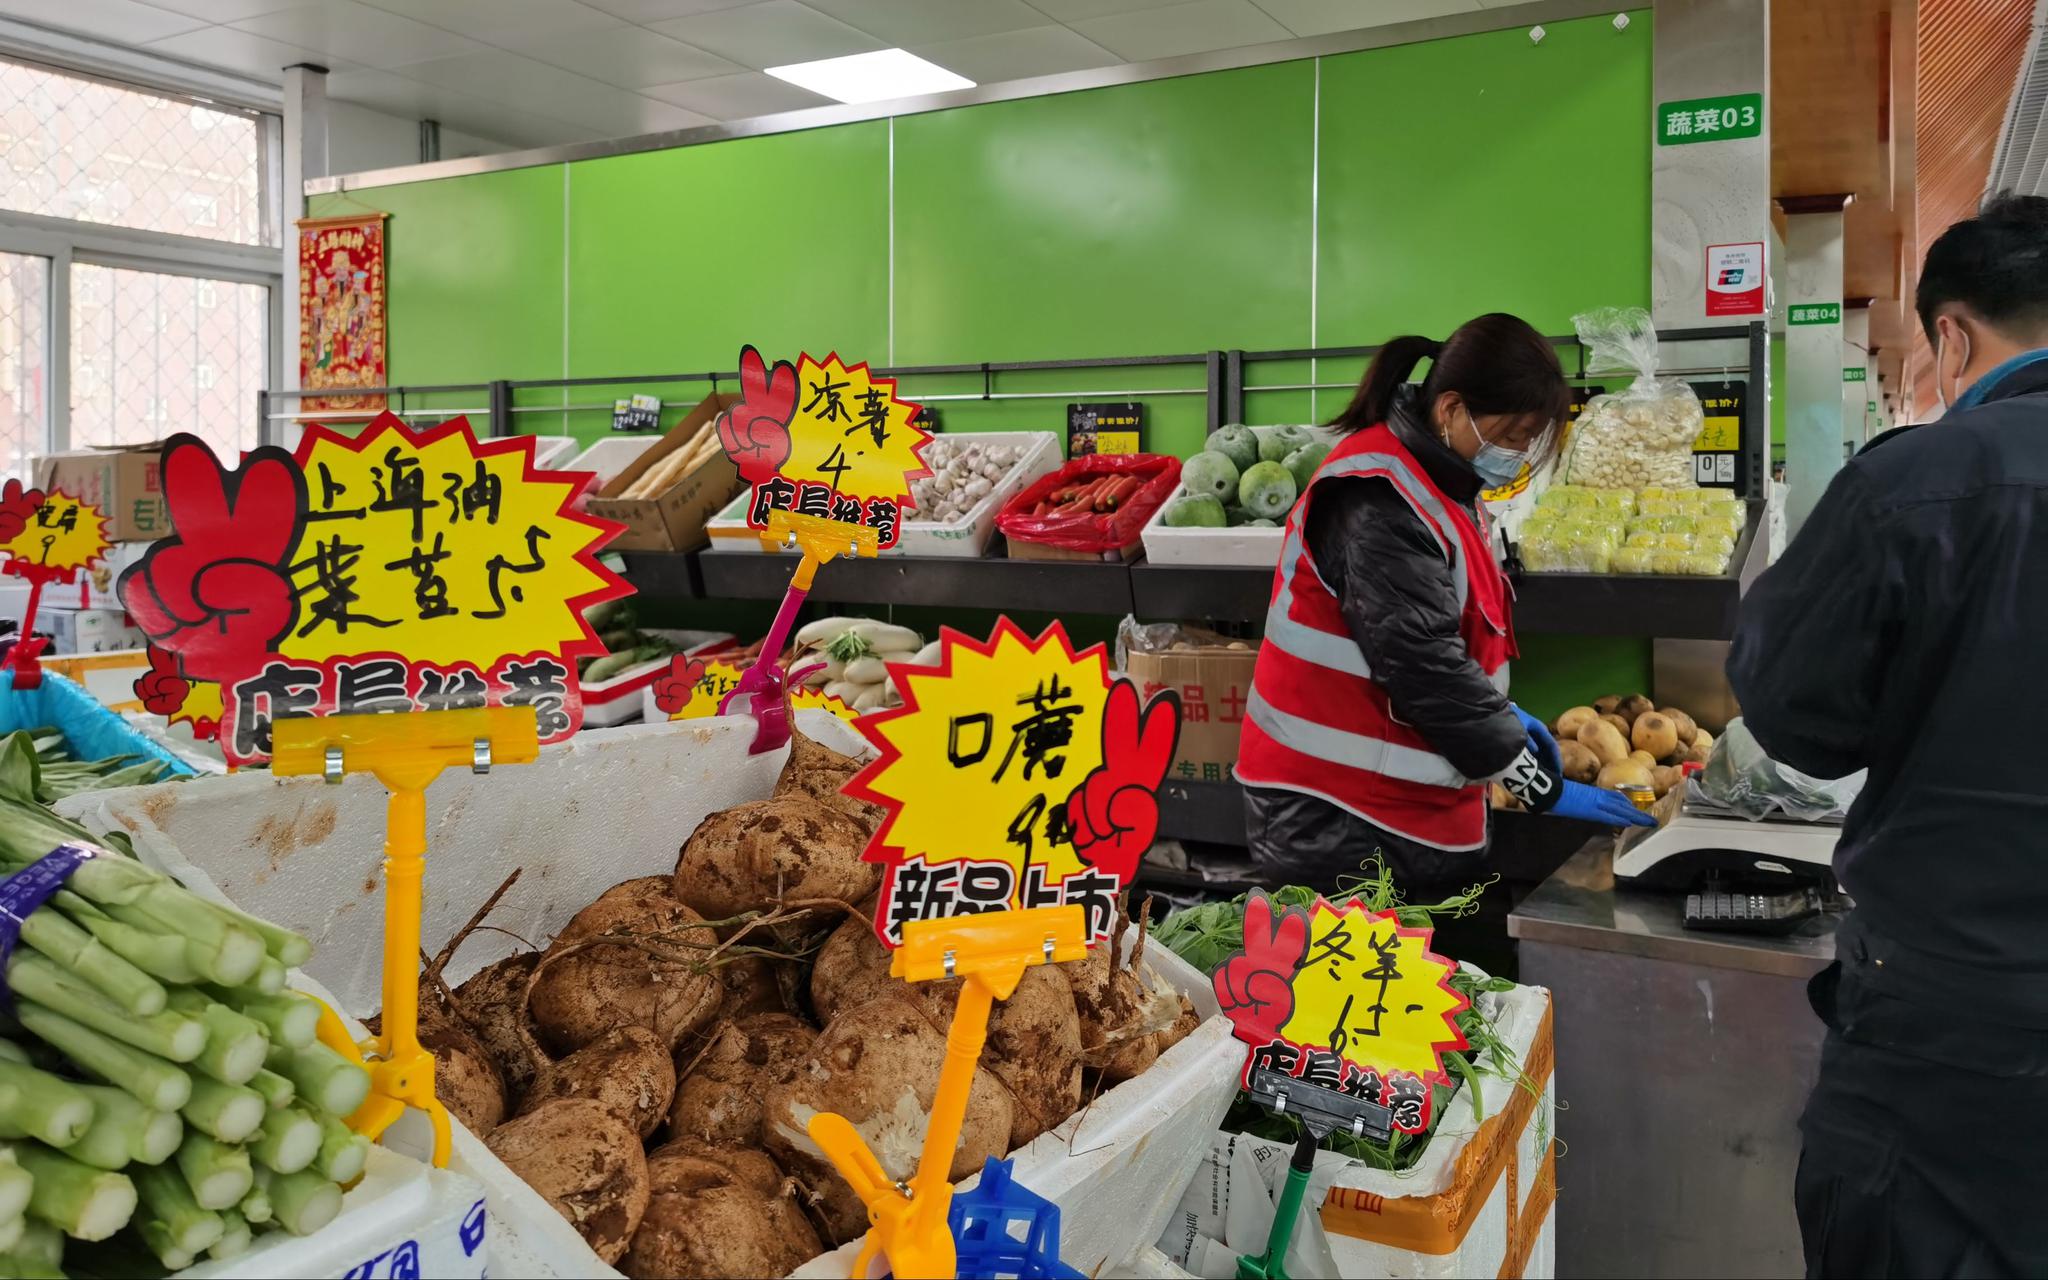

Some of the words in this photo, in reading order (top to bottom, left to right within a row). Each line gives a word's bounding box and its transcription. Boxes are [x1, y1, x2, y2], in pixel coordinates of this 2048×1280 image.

[1666, 106, 1755, 136] 蔬菜03
[1792, 308, 1838, 321] 蔬菜04
[884, 861, 1116, 943] 新品上市
